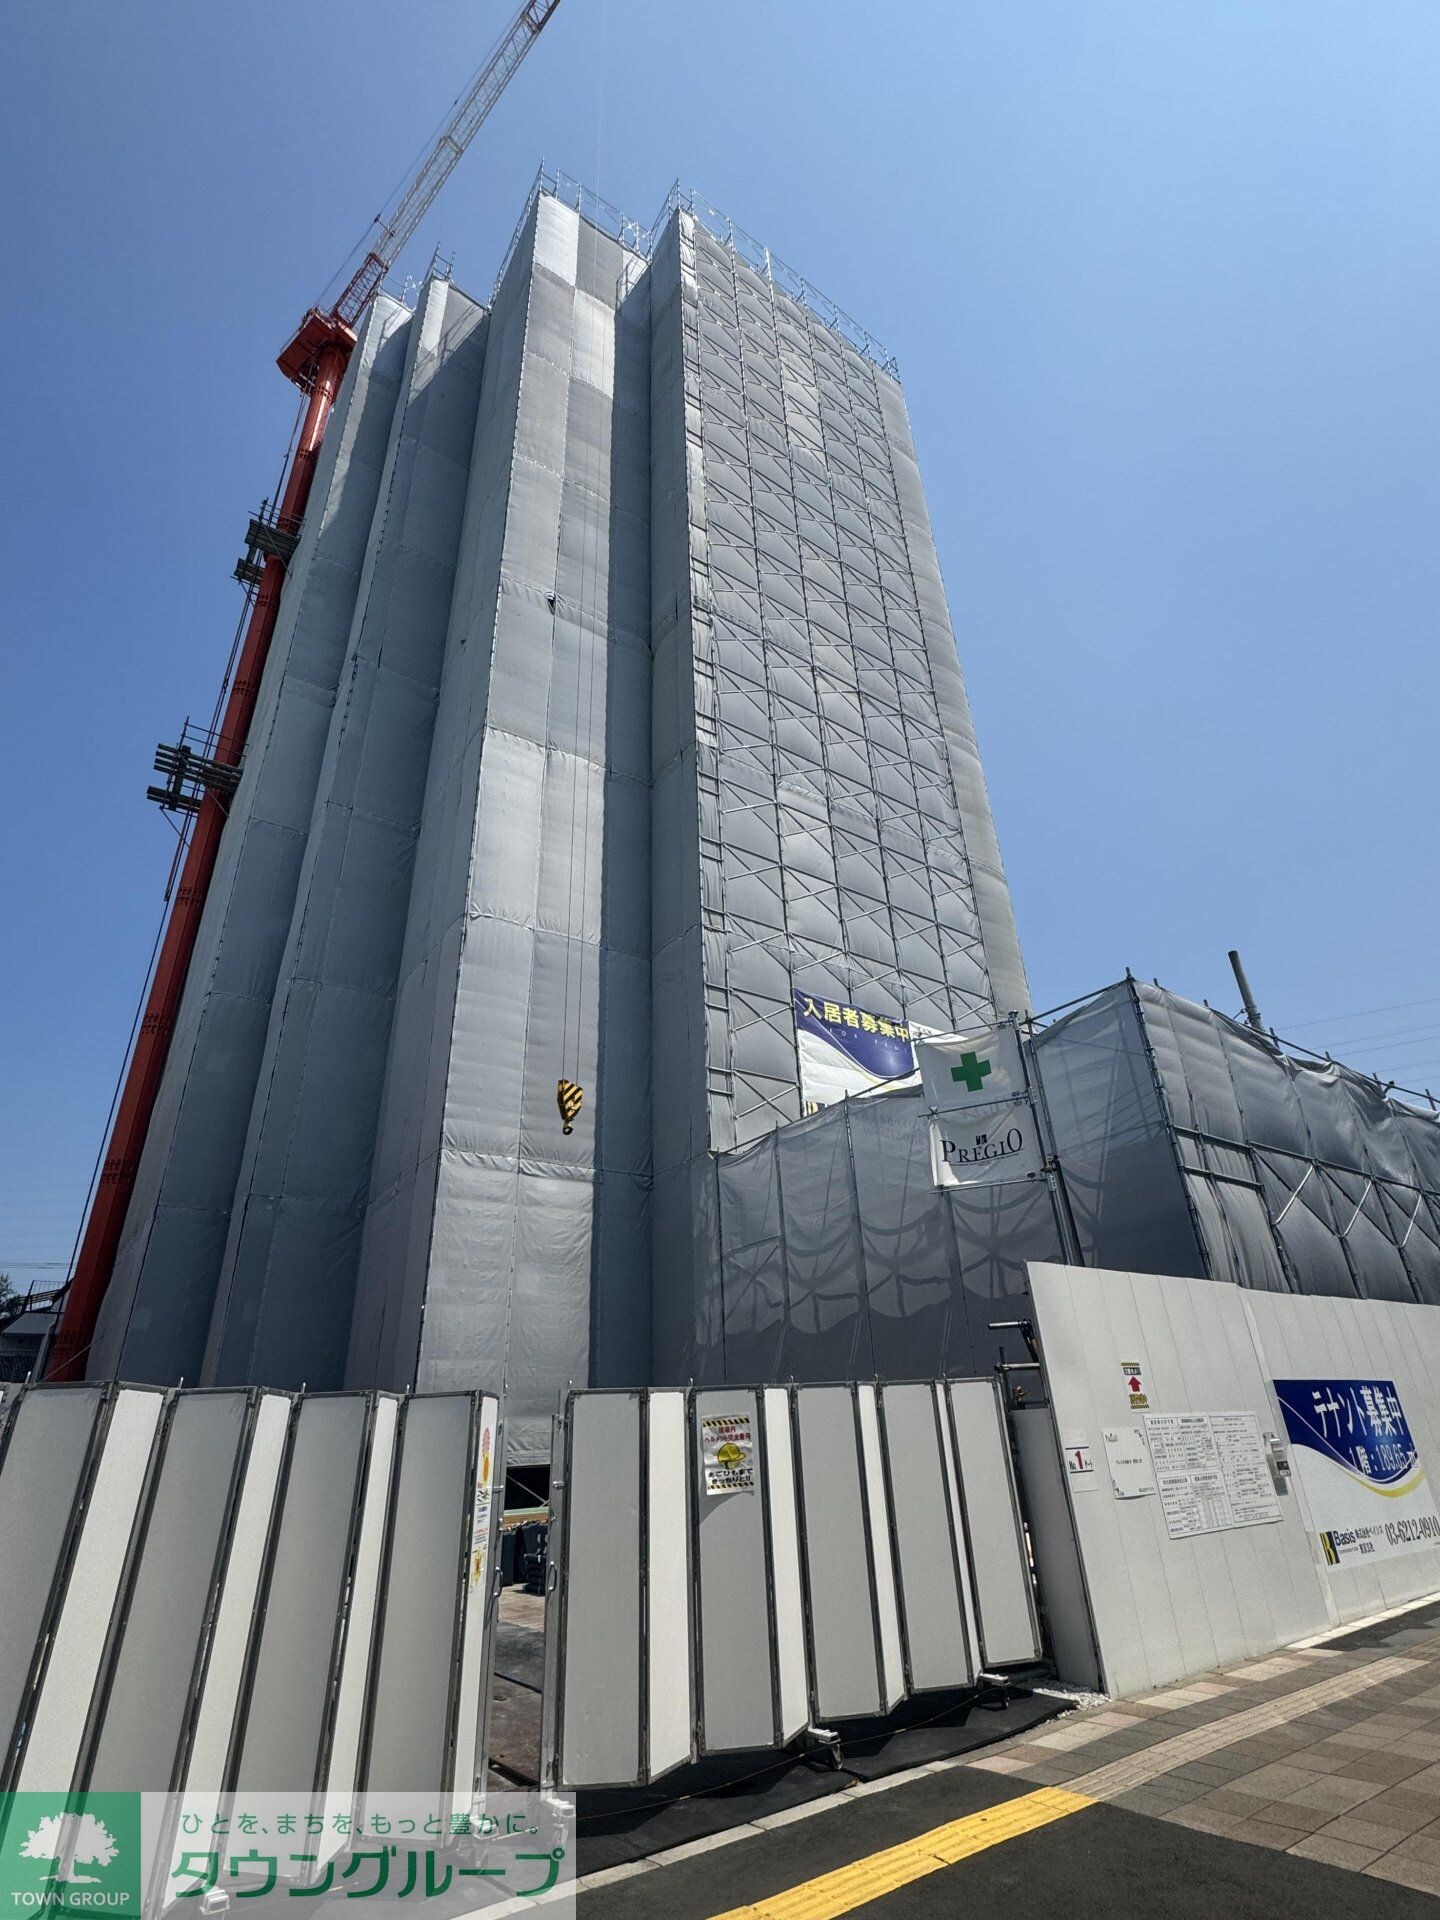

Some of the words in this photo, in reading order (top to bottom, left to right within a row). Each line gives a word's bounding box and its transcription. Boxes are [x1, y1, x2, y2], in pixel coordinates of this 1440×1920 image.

[803, 998, 910, 1042] 入居者募集中
[940, 1128, 1023, 1163] PREGIO
[1312, 1386, 1405, 1438] テナント募集中
[708, 1468, 753, 1477] あごひもまで
[1333, 1529, 1357, 1547] Basis
